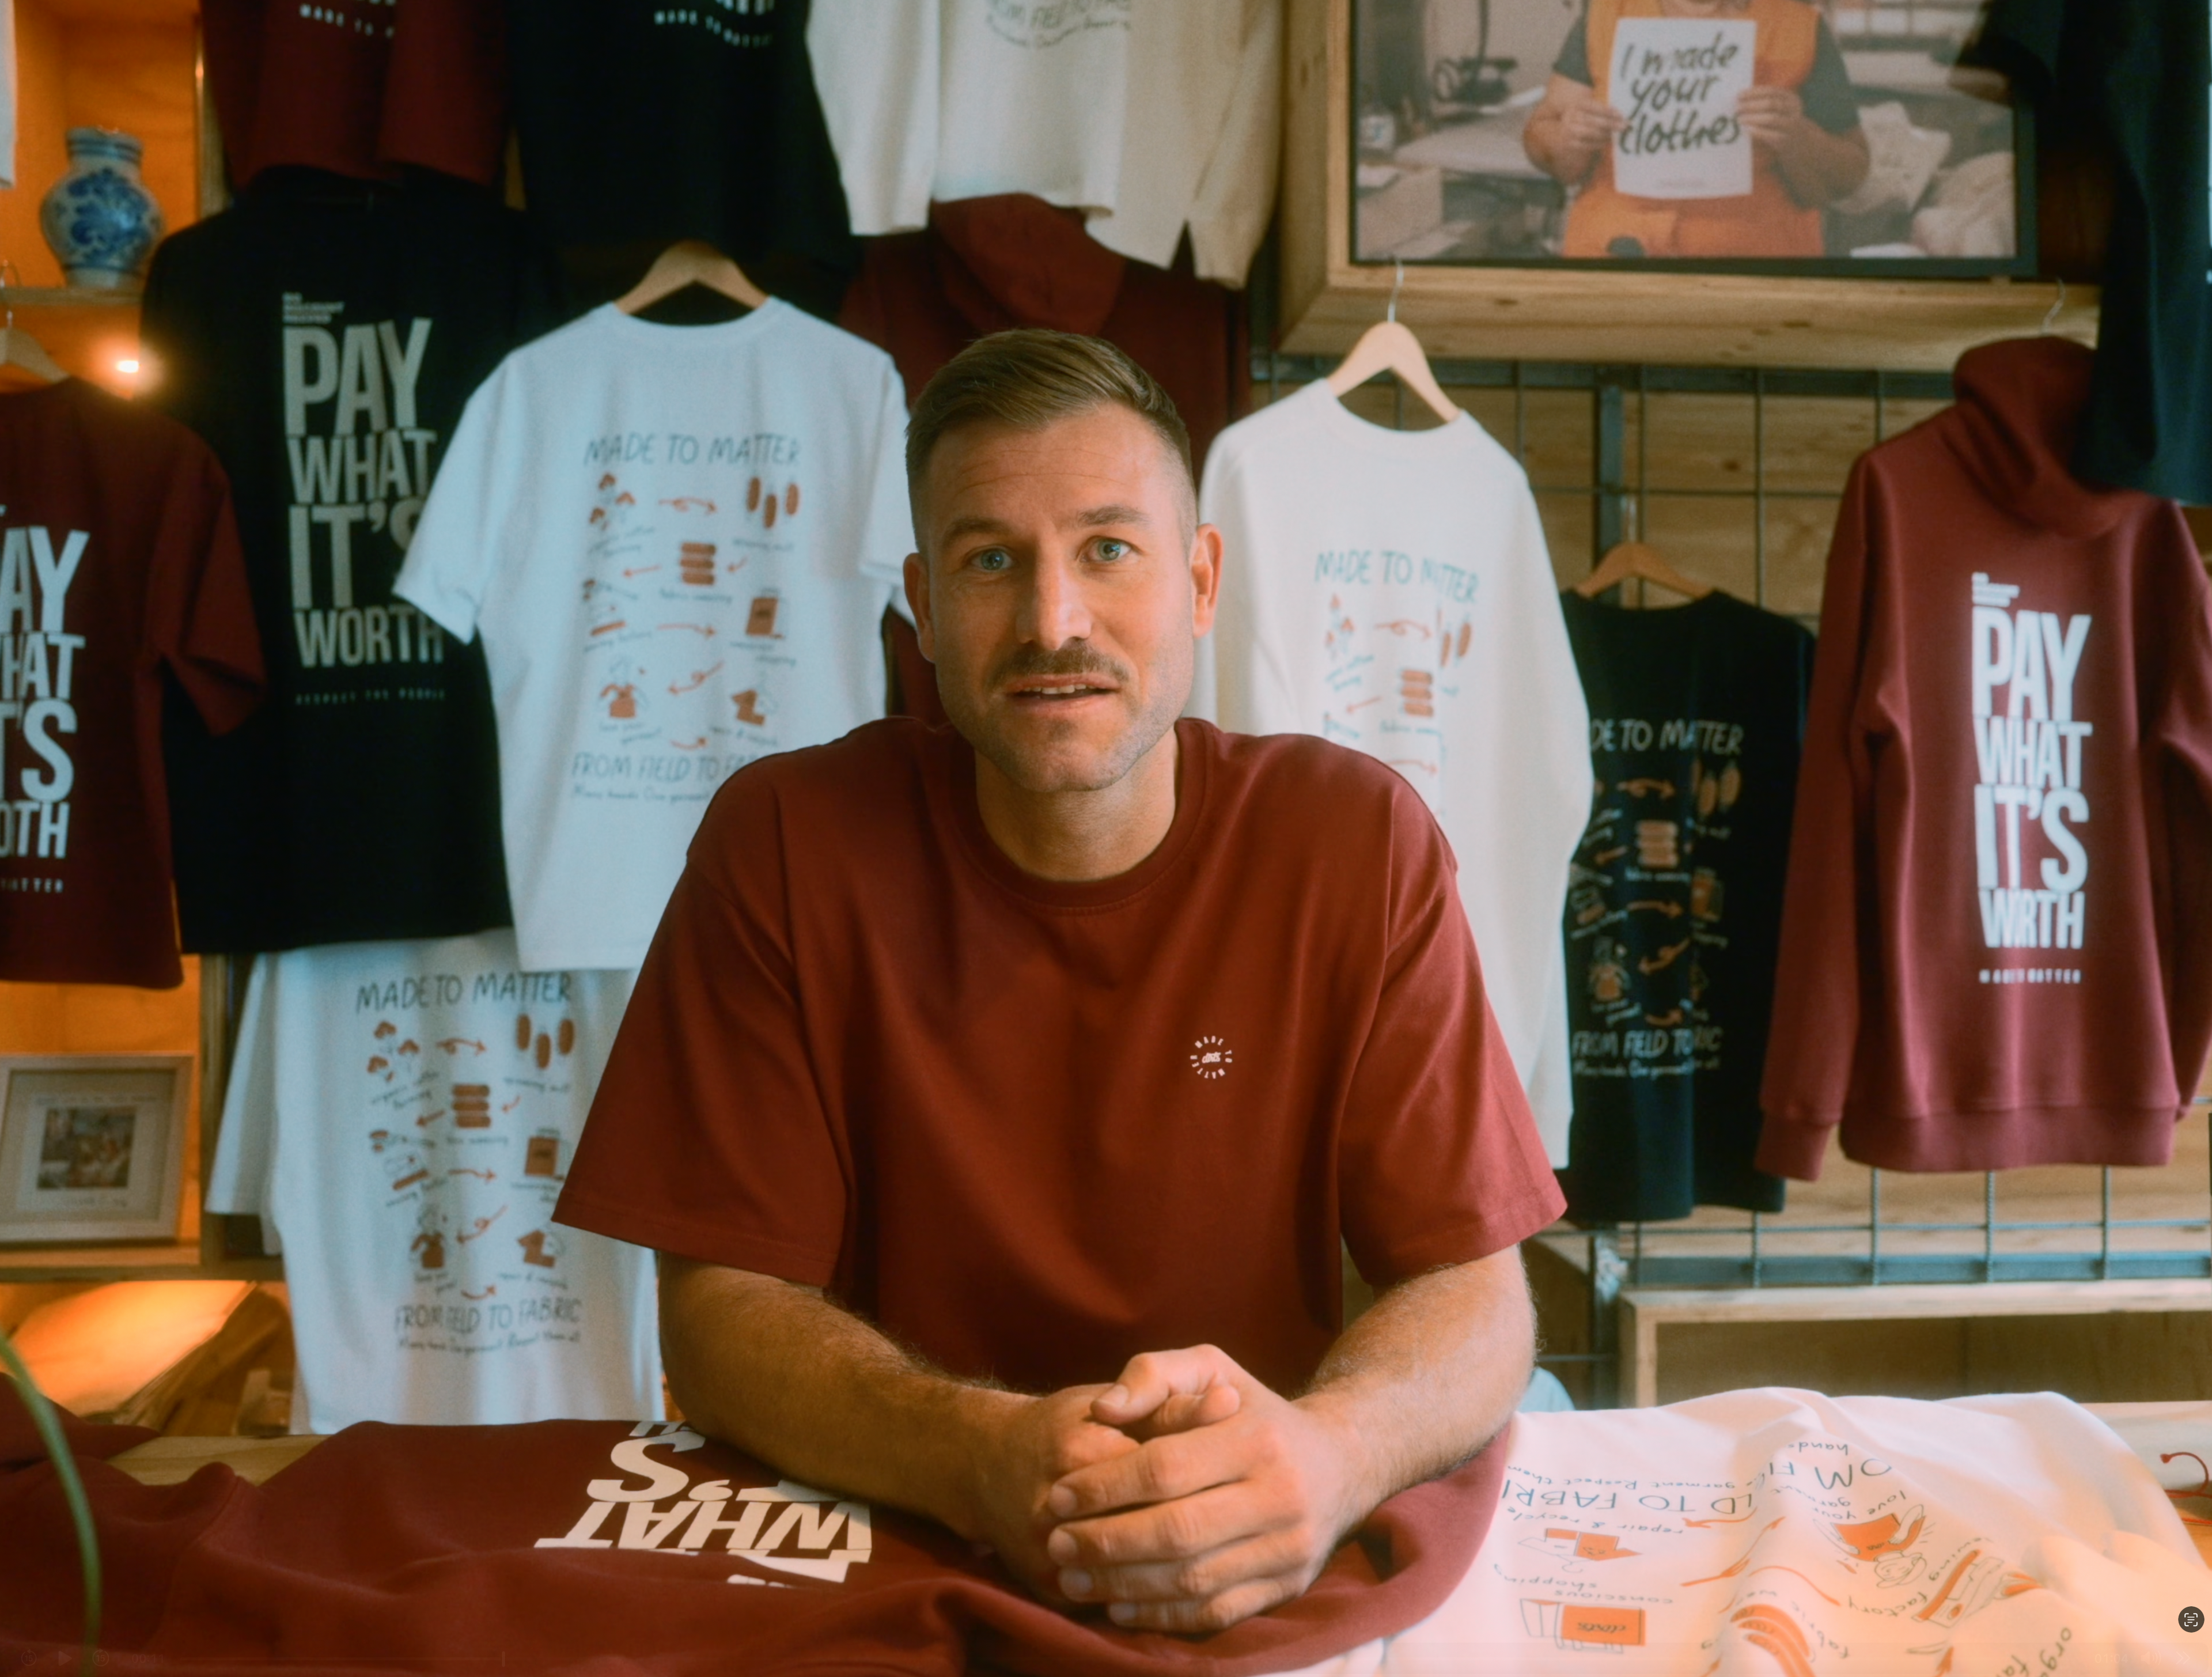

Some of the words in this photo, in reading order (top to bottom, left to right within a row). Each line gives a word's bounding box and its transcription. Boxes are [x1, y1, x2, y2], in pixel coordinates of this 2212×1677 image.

[1642, 32, 1738, 74] made
[1630, 76, 1720, 122] your
[1619, 109, 1740, 156] clothes
[283, 317, 433, 436] PAY
[287, 429, 438, 505] WHAT
[584, 432, 656, 466] MADE
[667, 434, 700, 463] TO
[707, 433, 802, 464] MATTER
[0, 525, 90, 633] AY
[1379, 550, 1414, 585] TO
[1421, 557, 1479, 604] MTTER
[294, 603, 444, 668] WORTH
[0, 630, 86, 701] HAT
[1972, 605, 2092, 723] PAY
[1618, 718, 1653, 752] TO
[1974, 716, 2093, 790] WHAT
[1975, 783, 2089, 893] IT'S
[356, 978, 431, 1015] MADE
[436, 975, 464, 1006] TO
[471, 971, 572, 1005] MATTER
[1501, 1478, 1618, 1511] FABRI
[1507, 1464, 1553, 1485] them
[1562, 1477, 1638, 1491] Respect
[1650, 1479, 1736, 1490] garment
[1506, 1505, 1581, 1526] recycle
[1638, 1494, 1696, 1513] TO
[1812, 1505, 1857, 1521] your
[1866, 1489, 1907, 1516] love
[533, 1500, 872, 1550] WHAT
[1617, 1523, 1684, 1537] repair
[1493, 1563, 1597, 1593] shopping
[1928, 1536, 1994, 1583] ewing
[1553, 1589, 1673, 1604] conscious
[1848, 1591, 1929, 1619] factory
[1790, 1600, 1851, 1660] fabric
